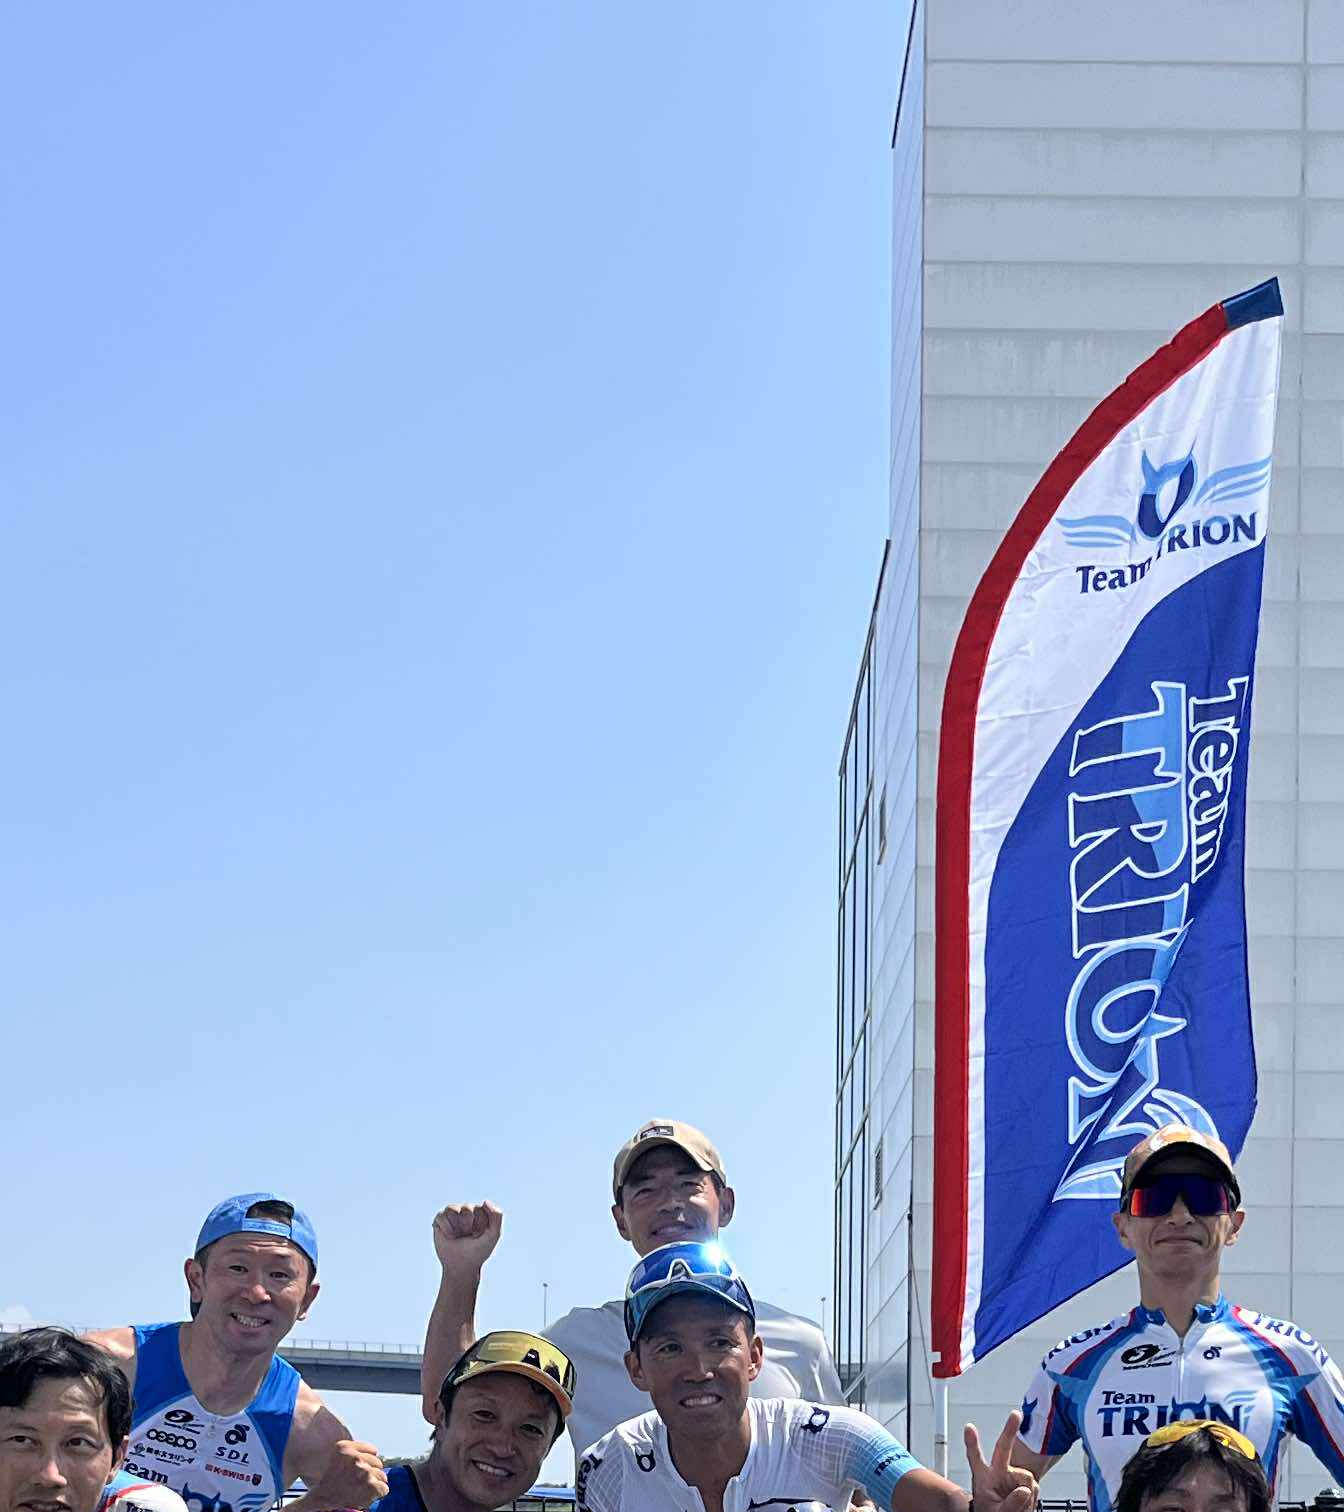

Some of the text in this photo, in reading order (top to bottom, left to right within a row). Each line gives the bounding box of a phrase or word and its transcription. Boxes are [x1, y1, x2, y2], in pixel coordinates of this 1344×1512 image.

[1076, 557, 1154, 595] Team
[1187, 676, 1250, 882] Team
[1102, 1391, 1155, 1406] Team
